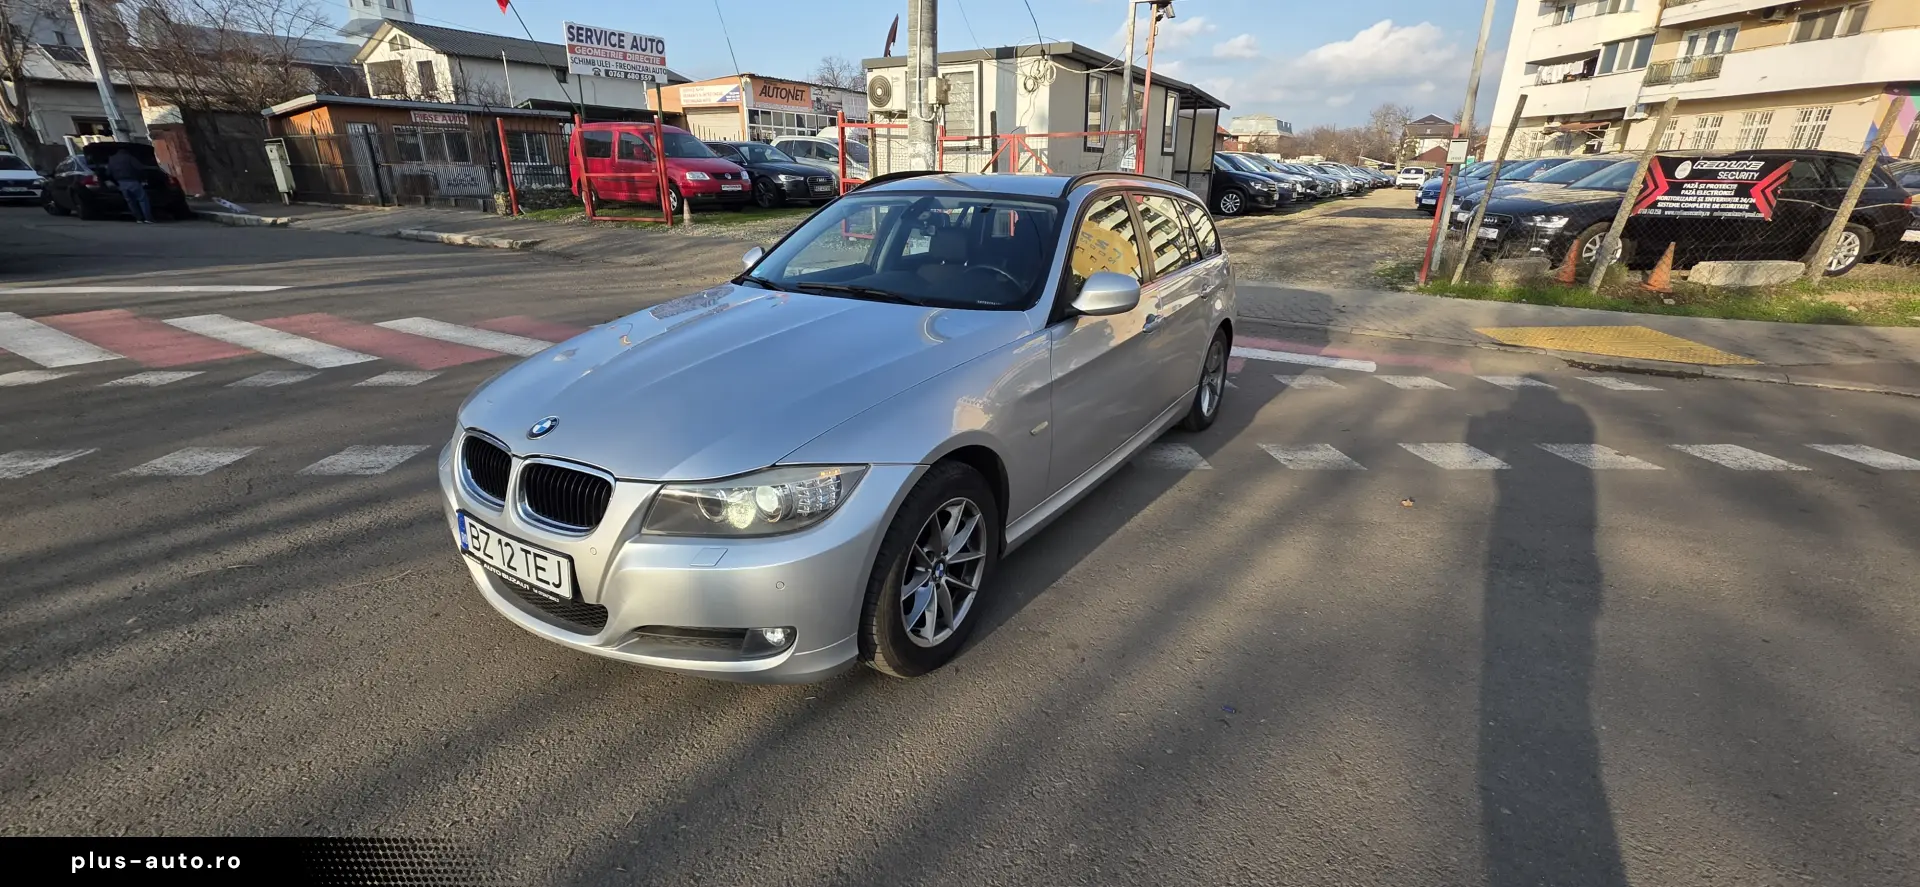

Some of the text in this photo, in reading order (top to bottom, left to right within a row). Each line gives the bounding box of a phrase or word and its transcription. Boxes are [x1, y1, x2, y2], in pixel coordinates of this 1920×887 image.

[567, 24, 665, 55] SERVICE AUTO
[574, 46, 661, 64] GEOMETRIE DIRECTIE
[570, 56, 596, 67] SCHIMB
[596, 60, 611, 68] ULEI
[651, 67, 667, 75] AUTO
[627, 72, 639, 80] 680
[759, 84, 806, 103] AUTONET
[1692, 160, 1765, 170] REDLINE
[1717, 171, 1760, 180] SECURITY
[468, 521, 562, 589] BZ 12 TEJ
[483, 563, 502, 577] AUTO
